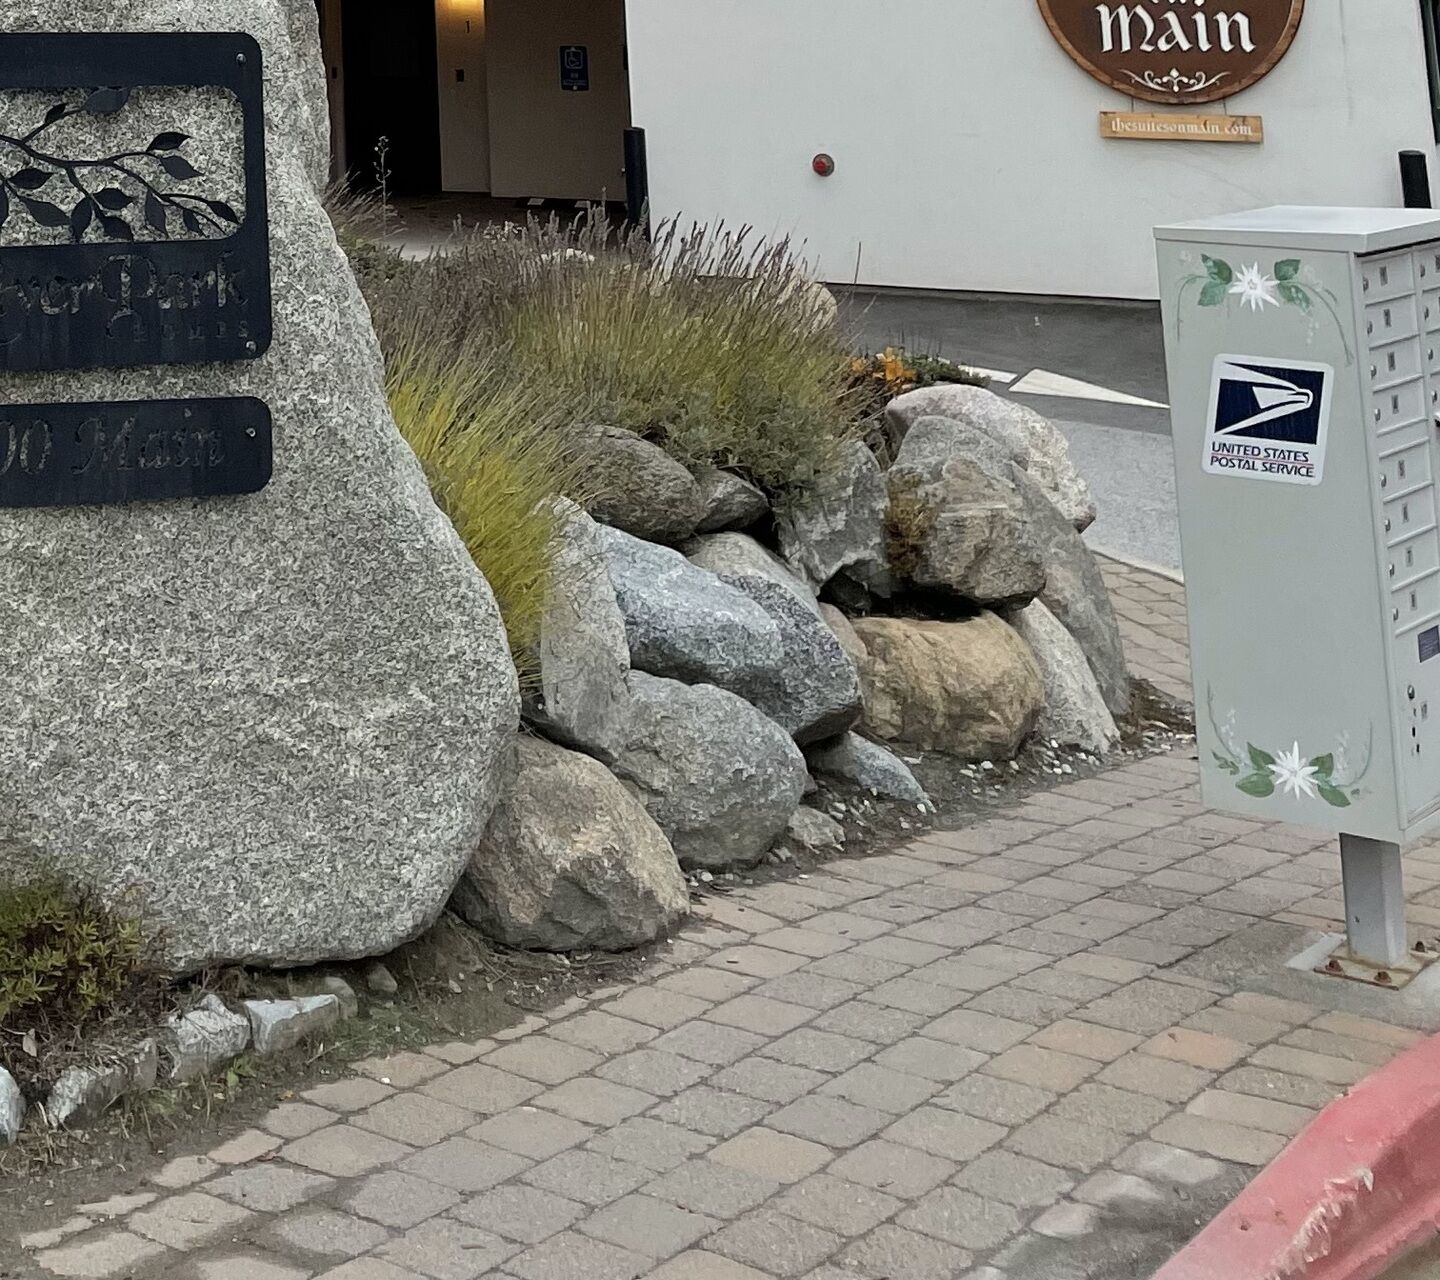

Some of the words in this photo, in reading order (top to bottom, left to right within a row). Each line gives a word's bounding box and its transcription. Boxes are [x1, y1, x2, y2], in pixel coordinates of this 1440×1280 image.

[1212, 441, 1261, 456] UNITED
[1264, 447, 1309, 462] STATES
[1210, 455, 1259, 471] POSTAL
[1261, 461, 1315, 478] SERVICE
